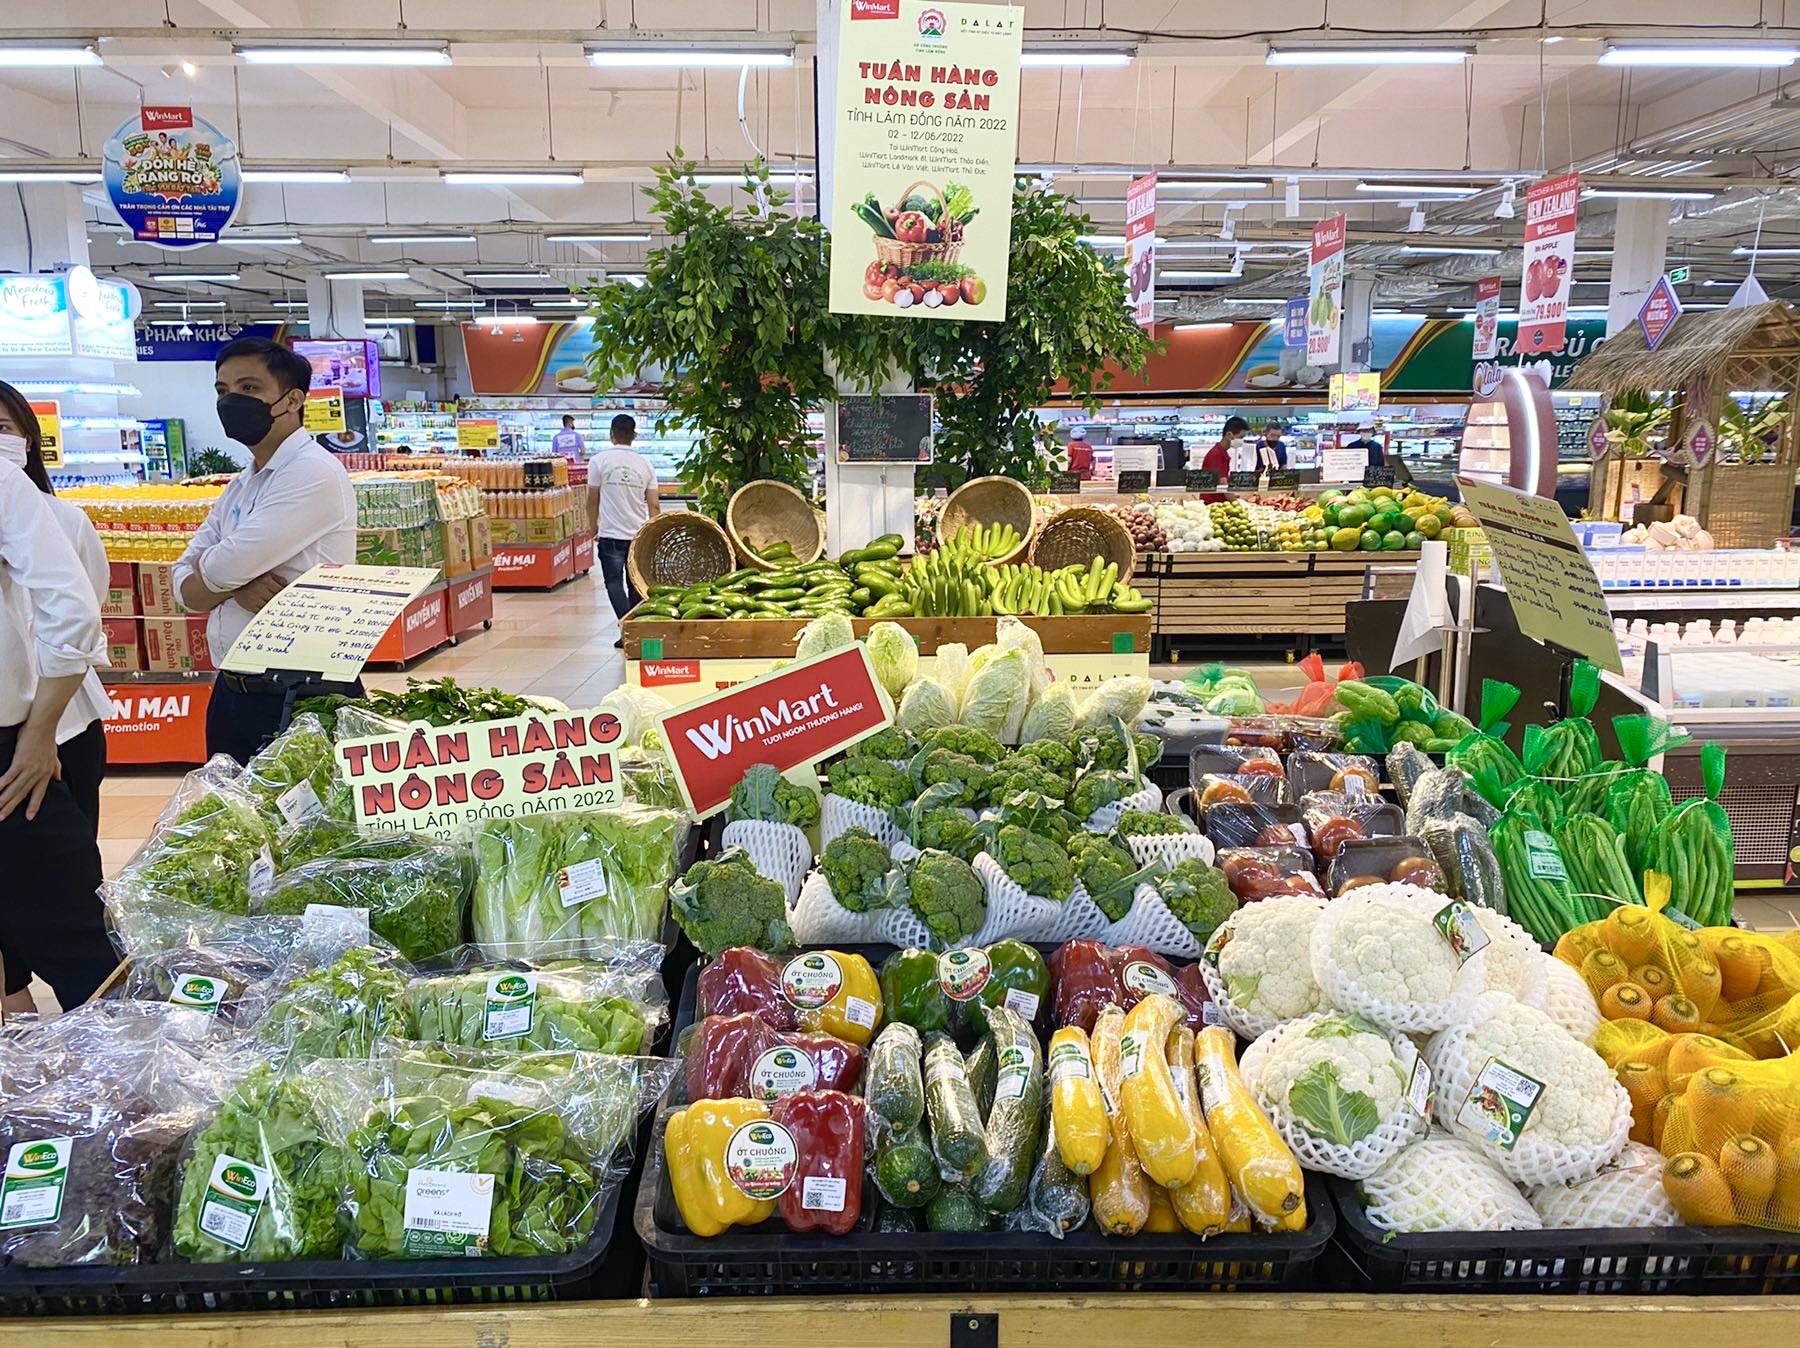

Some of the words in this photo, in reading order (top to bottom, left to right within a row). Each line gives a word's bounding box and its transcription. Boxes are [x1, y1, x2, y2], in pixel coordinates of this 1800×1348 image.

[855, 1, 891, 11] WinMart
[859, 58, 921, 82] TUẦN
[931, 64, 998, 87] HÀNG
[865, 85, 935, 108] NÔNG
[944, 89, 990, 111] SẢN
[145, 111, 182, 121] WinMart
[979, 118, 1007, 130] 2022
[888, 129, 899, 139] 02
[910, 131, 964, 142] 12/06/2022
[859, 152, 888, 160] WinMart
[889, 153, 919, 161] Landmark
[900, 144, 927, 152] WinMart
[862, 161, 890, 169] WinMart
[931, 165, 960, 173] WinMart
[1528, 199, 1543, 220] NEW
[1543, 190, 1576, 214] ZEALAND
[1314, 228, 1339, 248] WinMart
[3, 284, 54, 302] Meadow
[22, 295, 52, 308] Fresh
[514, 555, 536, 568] MẠI
[162, 592, 171, 615] Nành
[458, 583, 476, 609] KHUYẾN
[407, 600, 430, 633] KHUYẾN
[430, 598, 441, 618] MẠI
[164, 621, 174, 646] Đậu
[168, 647, 176, 669] Nành
[645, 665, 689, 676] WinMart
[138, 695, 191, 723] MẠI
[104, 721, 160, 733] Promotion
[685, 683, 839, 761] WinMart
[782, 725, 807, 742] NGON
[343, 727, 470, 777] TUẦN
[488, 713, 622, 758] HÀNG
[362, 769, 504, 816] NÔNG
[522, 751, 613, 793] SẢN
[574, 789, 615, 808] 2022
[773, 1070, 806, 1078] CHUÔNG
[24, 1152, 57, 1164] WinEco
[736, 1147, 748, 1156] ỚT
[750, 1147, 787, 1156] CHUÔNG
[226, 1169, 256, 1188] WinEco
